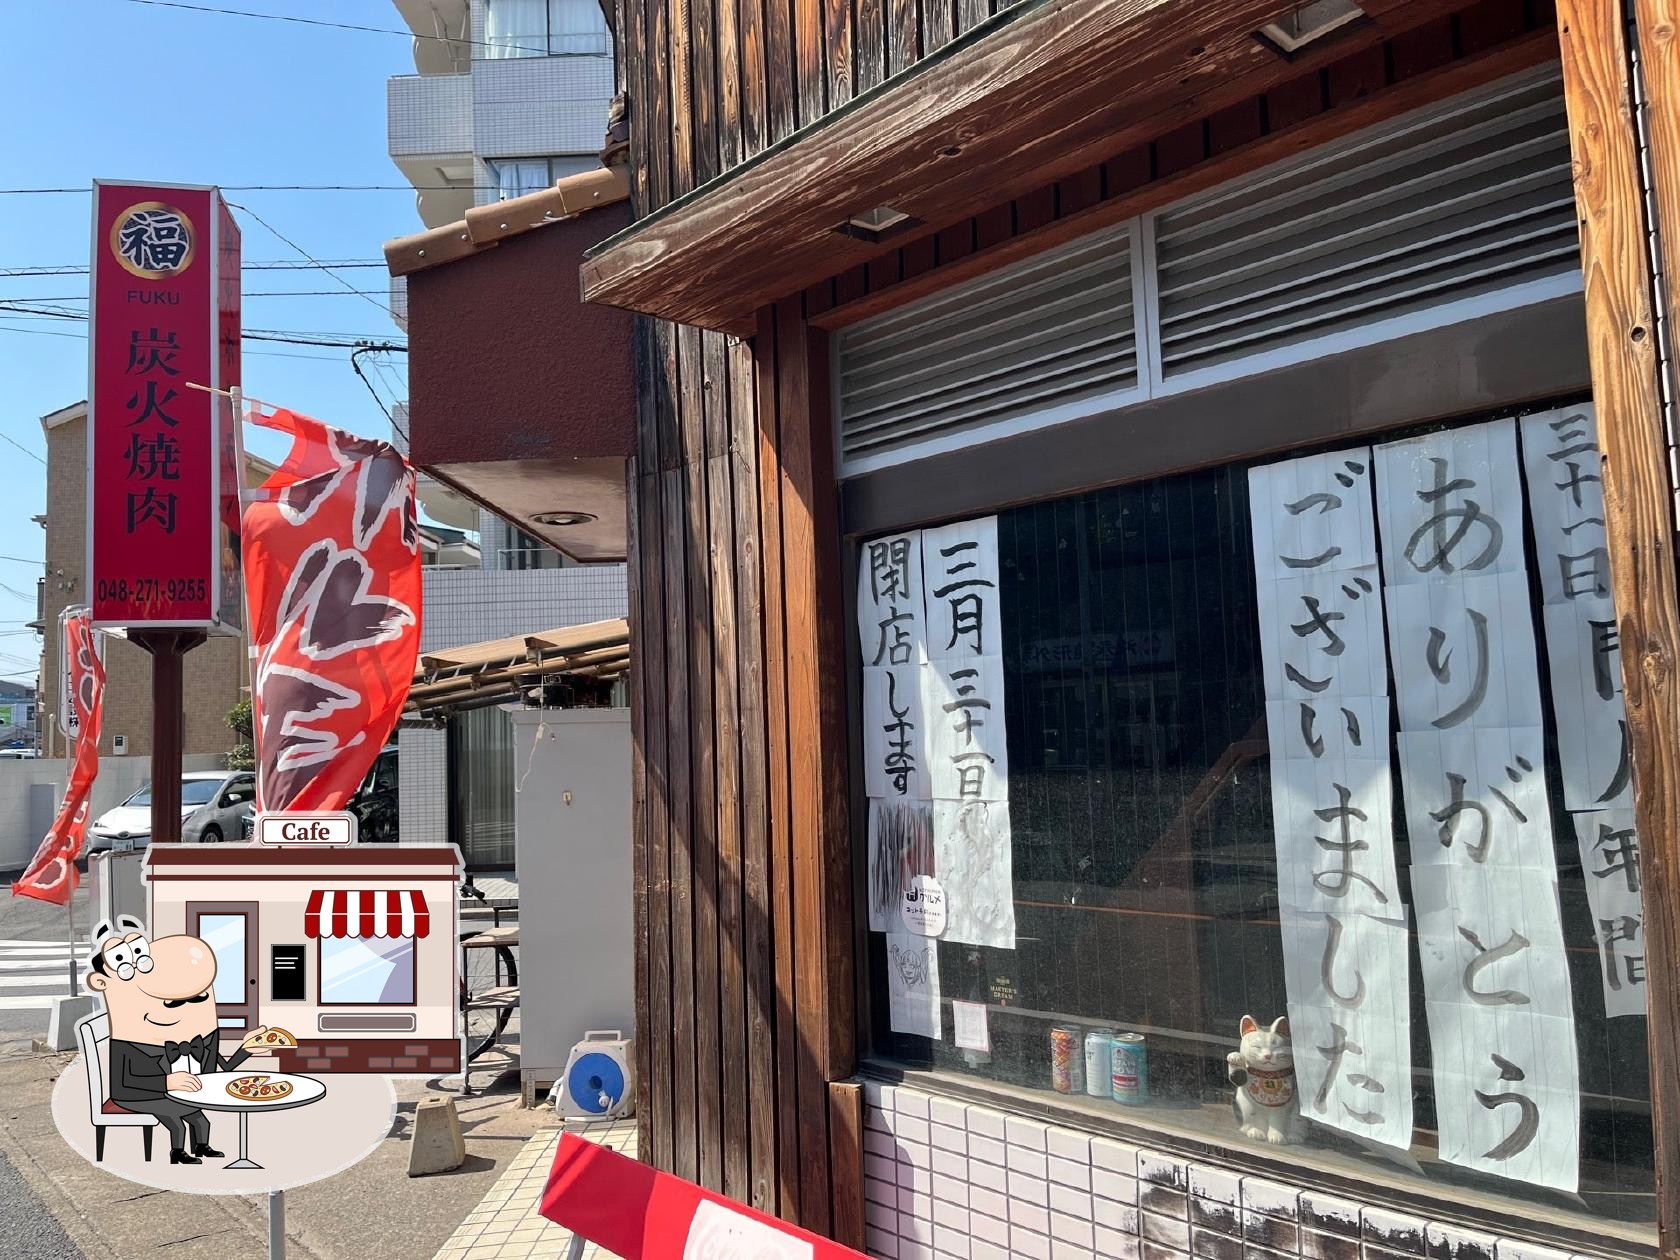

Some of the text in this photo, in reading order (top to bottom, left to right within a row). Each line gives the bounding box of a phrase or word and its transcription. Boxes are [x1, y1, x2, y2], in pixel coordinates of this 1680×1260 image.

[119, 210, 189, 270] 福
[127, 290, 181, 306] FUKU
[123, 327, 182, 535] 炭火焼肉
[97, 577, 207, 602] 048-271-9255
[868, 537, 916, 796] 閉店します
[933, 540, 997, 799] 三月三十一日
[1278, 460, 1389, 1125] ございました
[1403, 456, 1540, 1162] ありがとう
